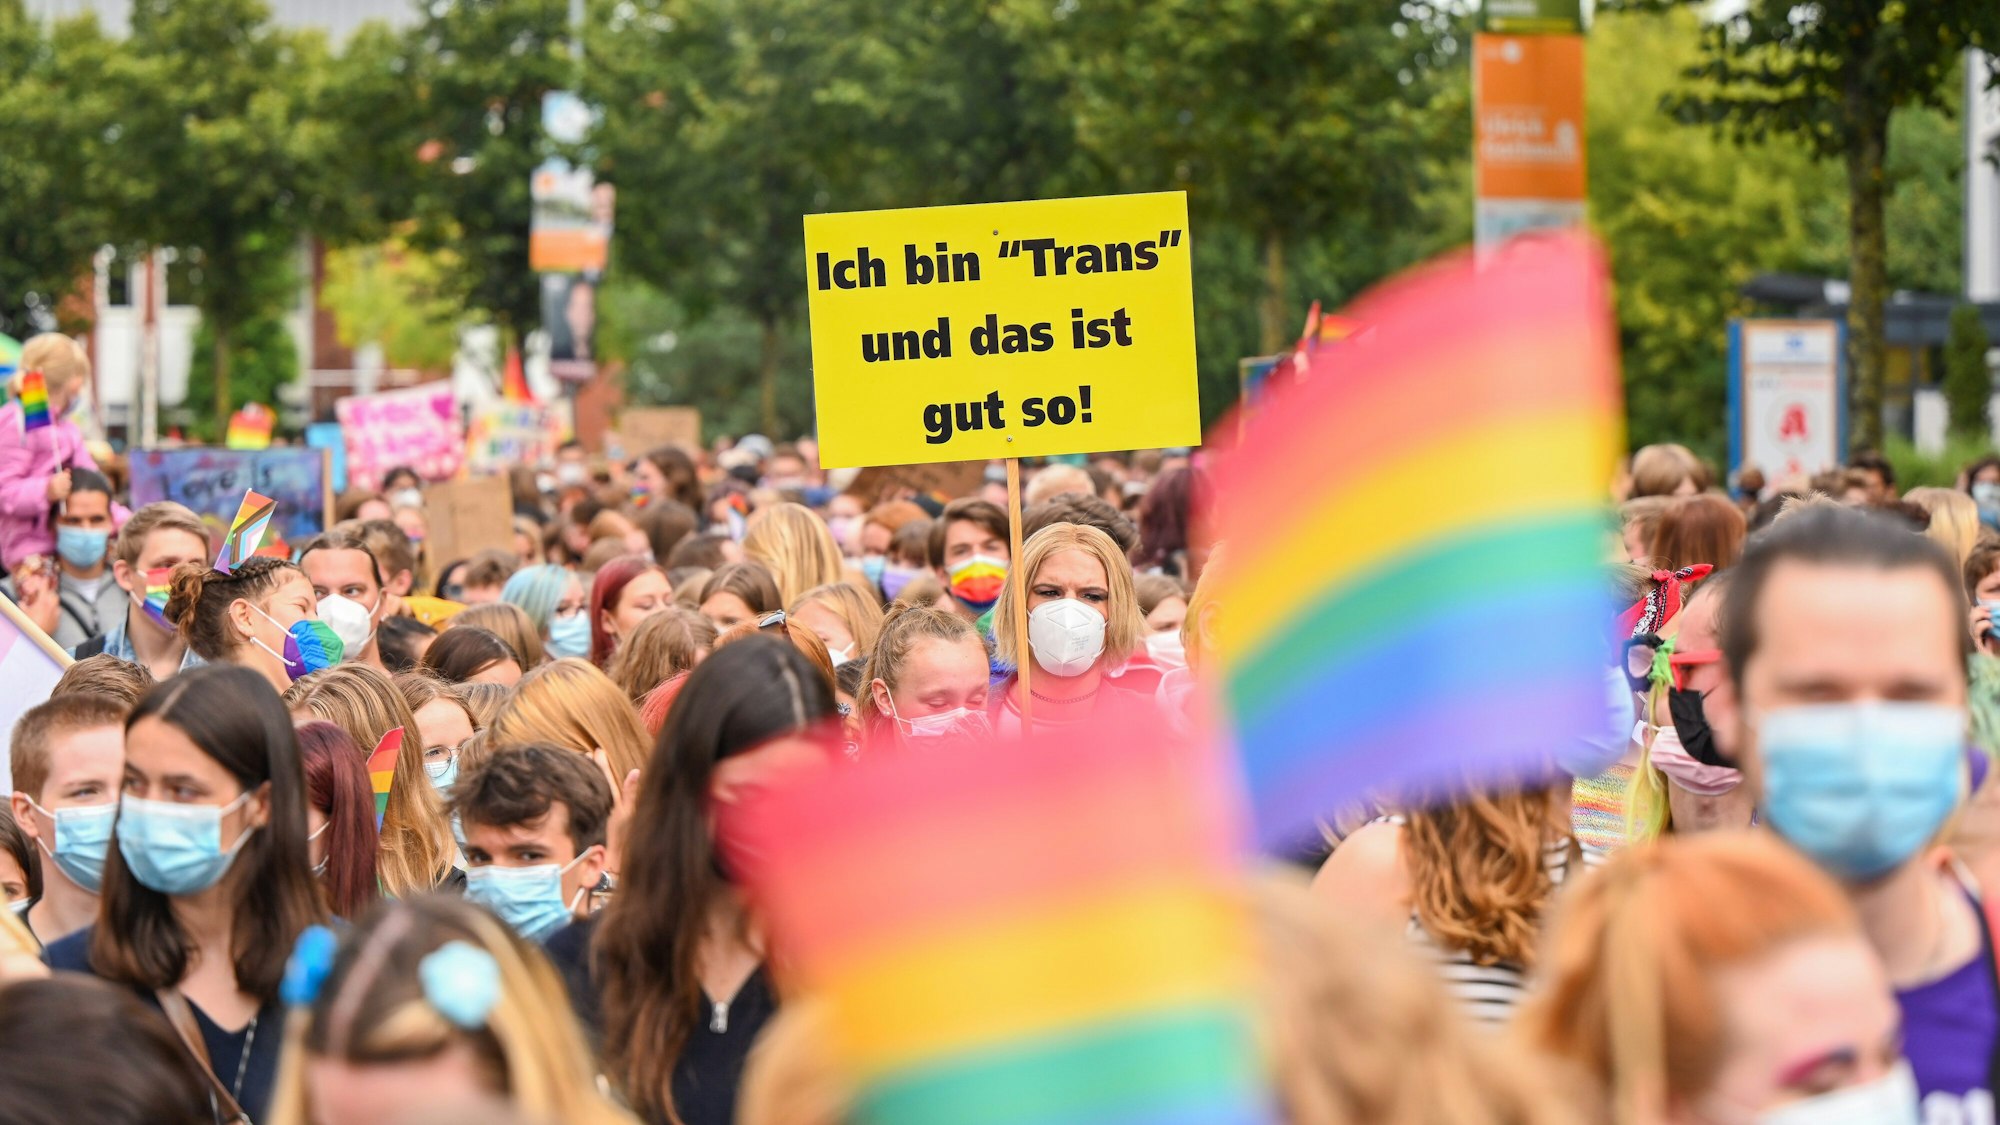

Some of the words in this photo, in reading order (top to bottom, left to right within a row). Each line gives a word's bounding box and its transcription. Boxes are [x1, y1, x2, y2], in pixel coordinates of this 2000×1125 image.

[816, 246, 887, 291] Ich
[904, 241, 981, 286] bin
[861, 316, 952, 363] und
[969, 313, 1054, 356] das
[1071, 307, 1133, 350] ist
[923, 390, 1006, 445] gut
[1021, 385, 1093, 428] so!
